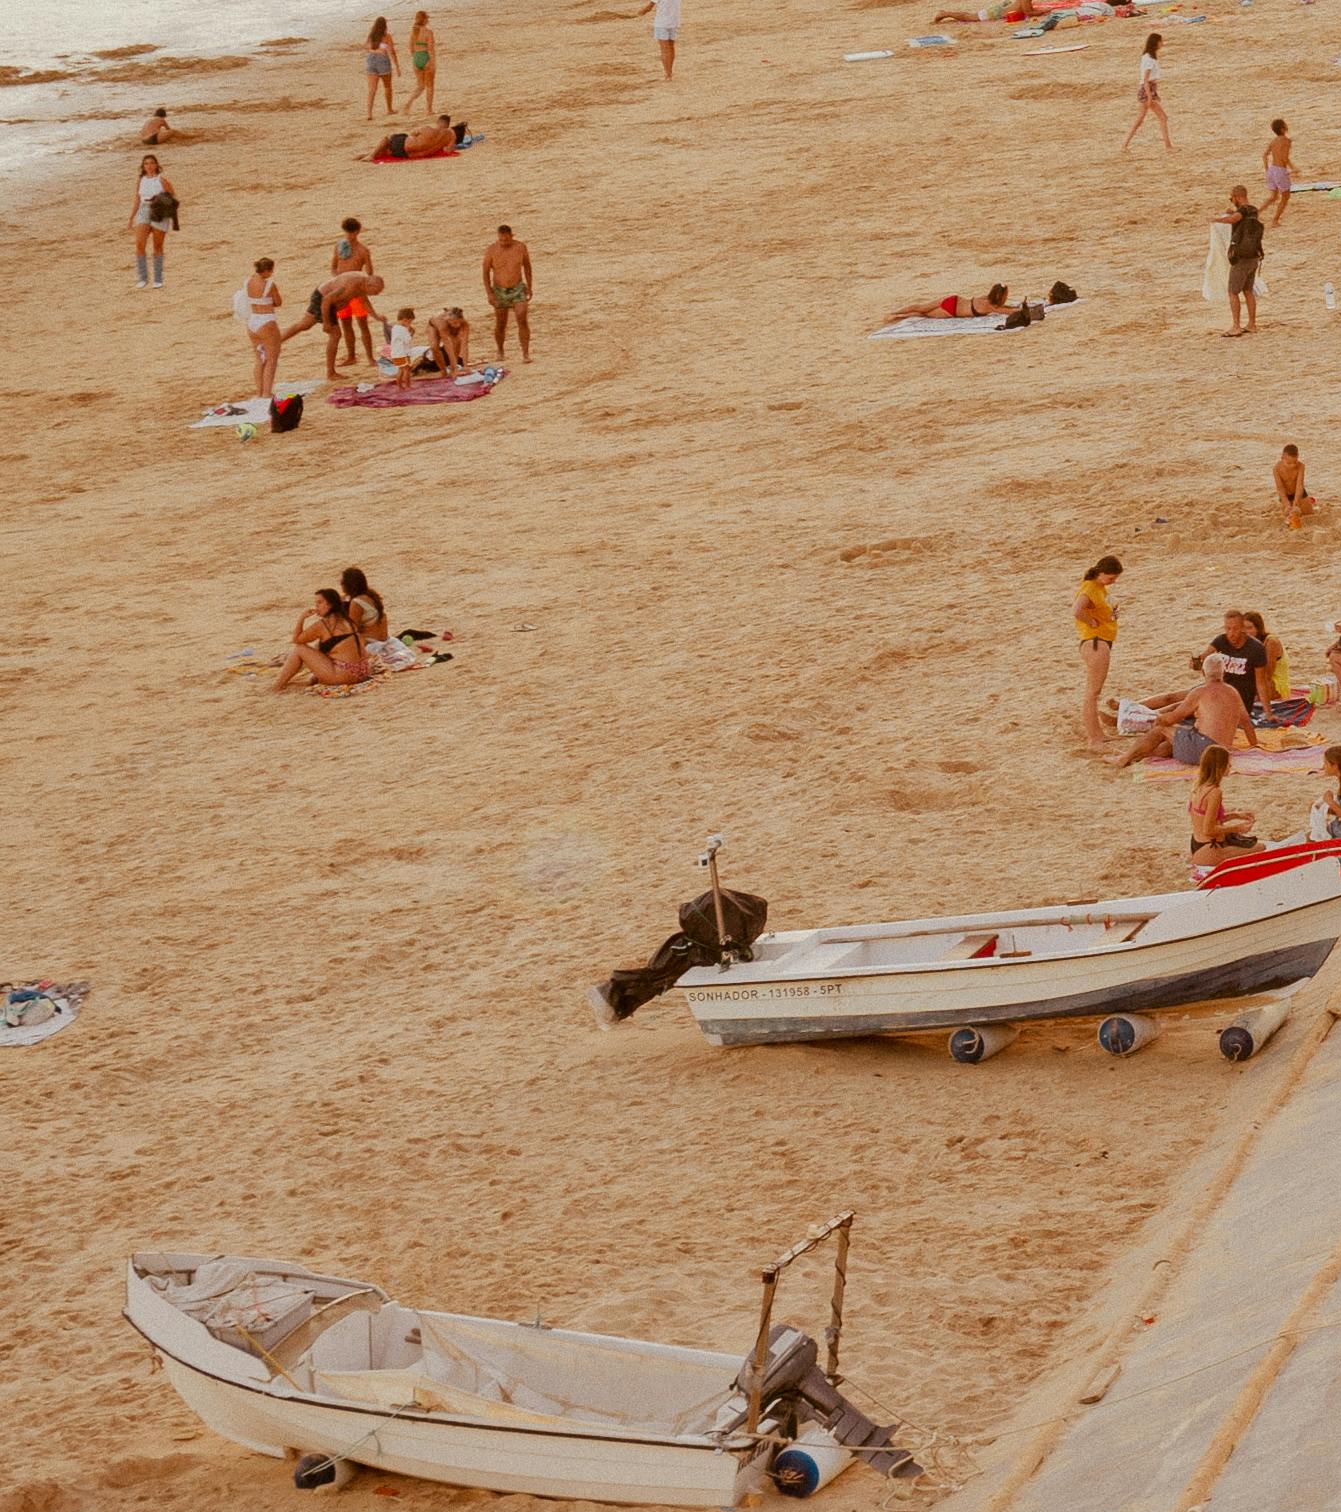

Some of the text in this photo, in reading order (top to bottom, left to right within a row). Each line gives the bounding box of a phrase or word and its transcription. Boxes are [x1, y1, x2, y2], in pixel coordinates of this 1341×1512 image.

[689, 990, 759, 1002] SONHADOR
[769, 986, 811, 999] 131958
[820, 984, 843, 995] 5PT
